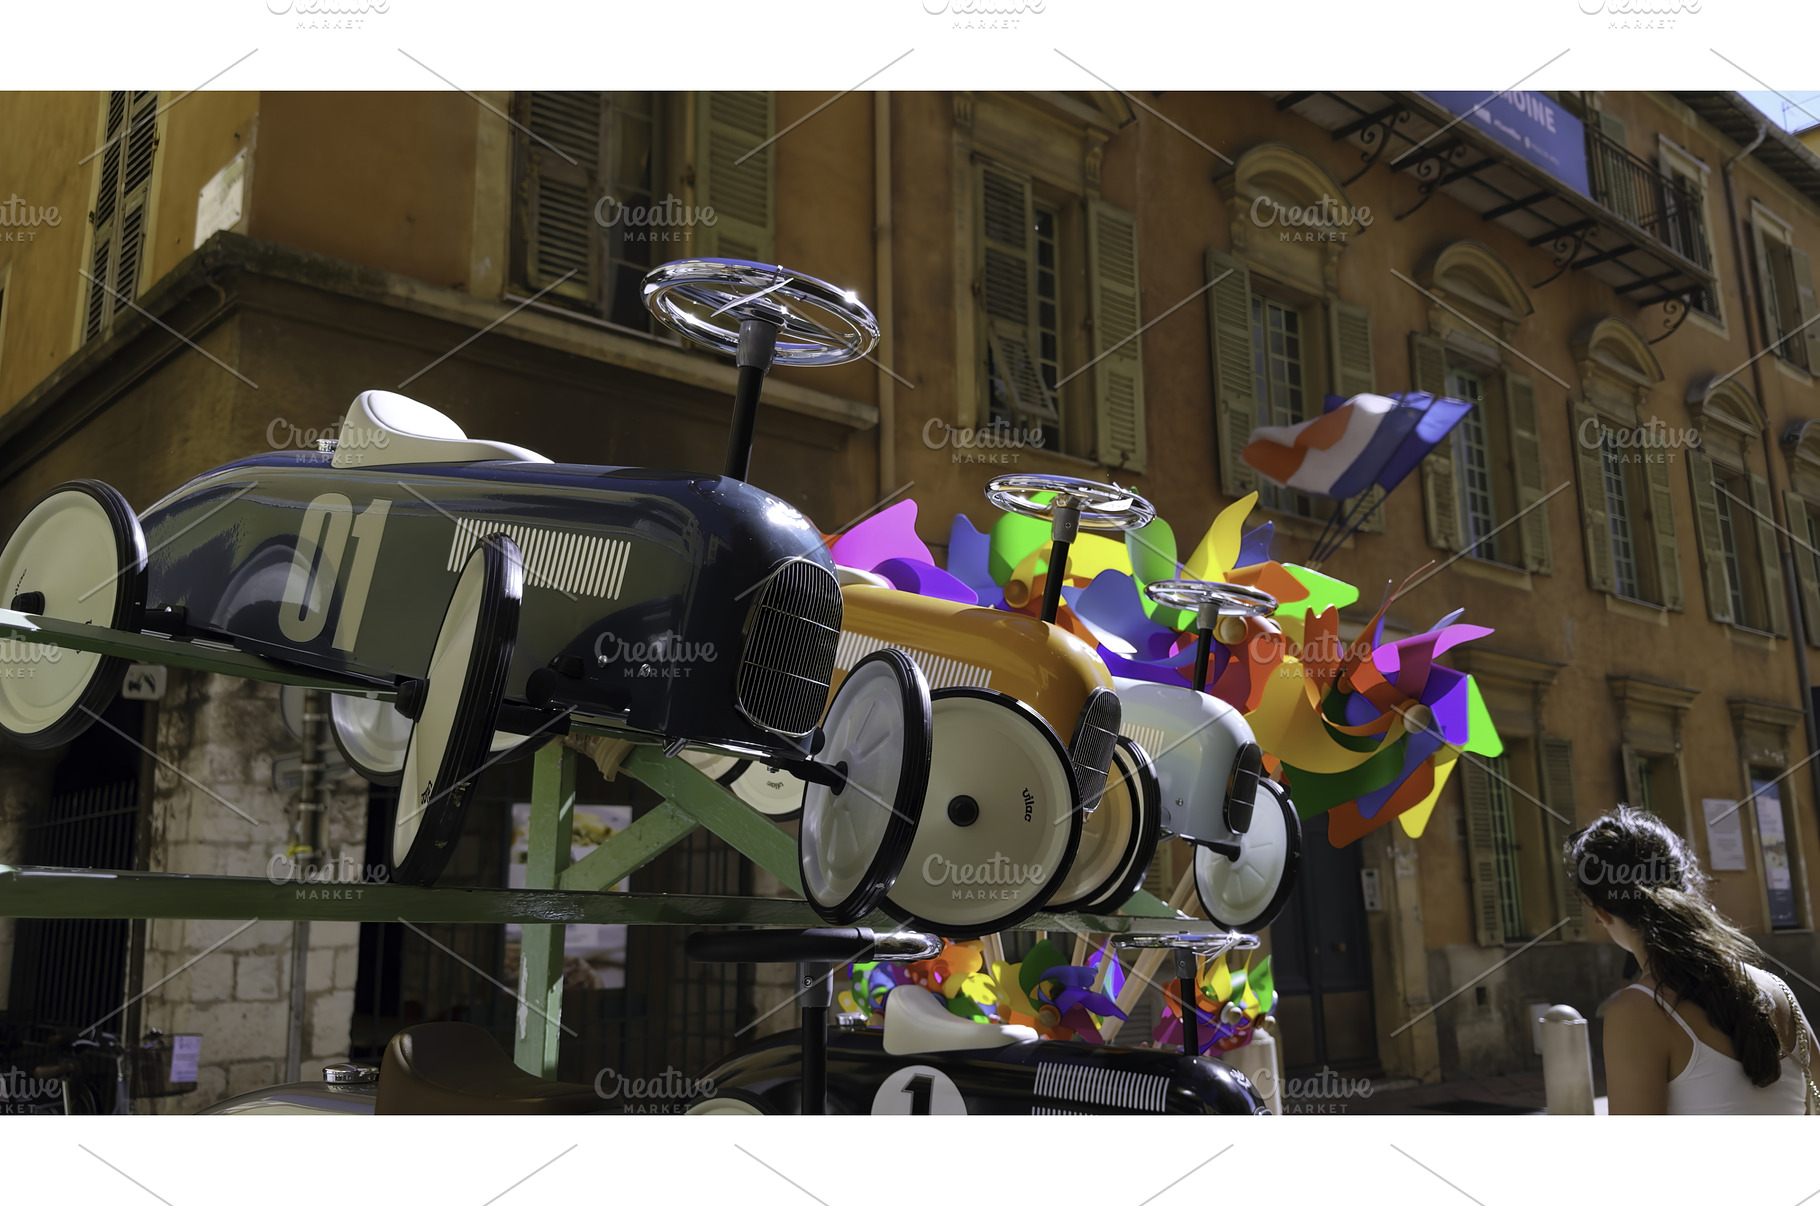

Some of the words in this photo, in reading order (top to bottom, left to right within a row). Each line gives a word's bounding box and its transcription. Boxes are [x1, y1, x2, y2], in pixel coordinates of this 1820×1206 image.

[279, 493, 392, 653] 01
[1022, 787, 1034, 822] vilac
[901, 1073, 935, 1115] 1
